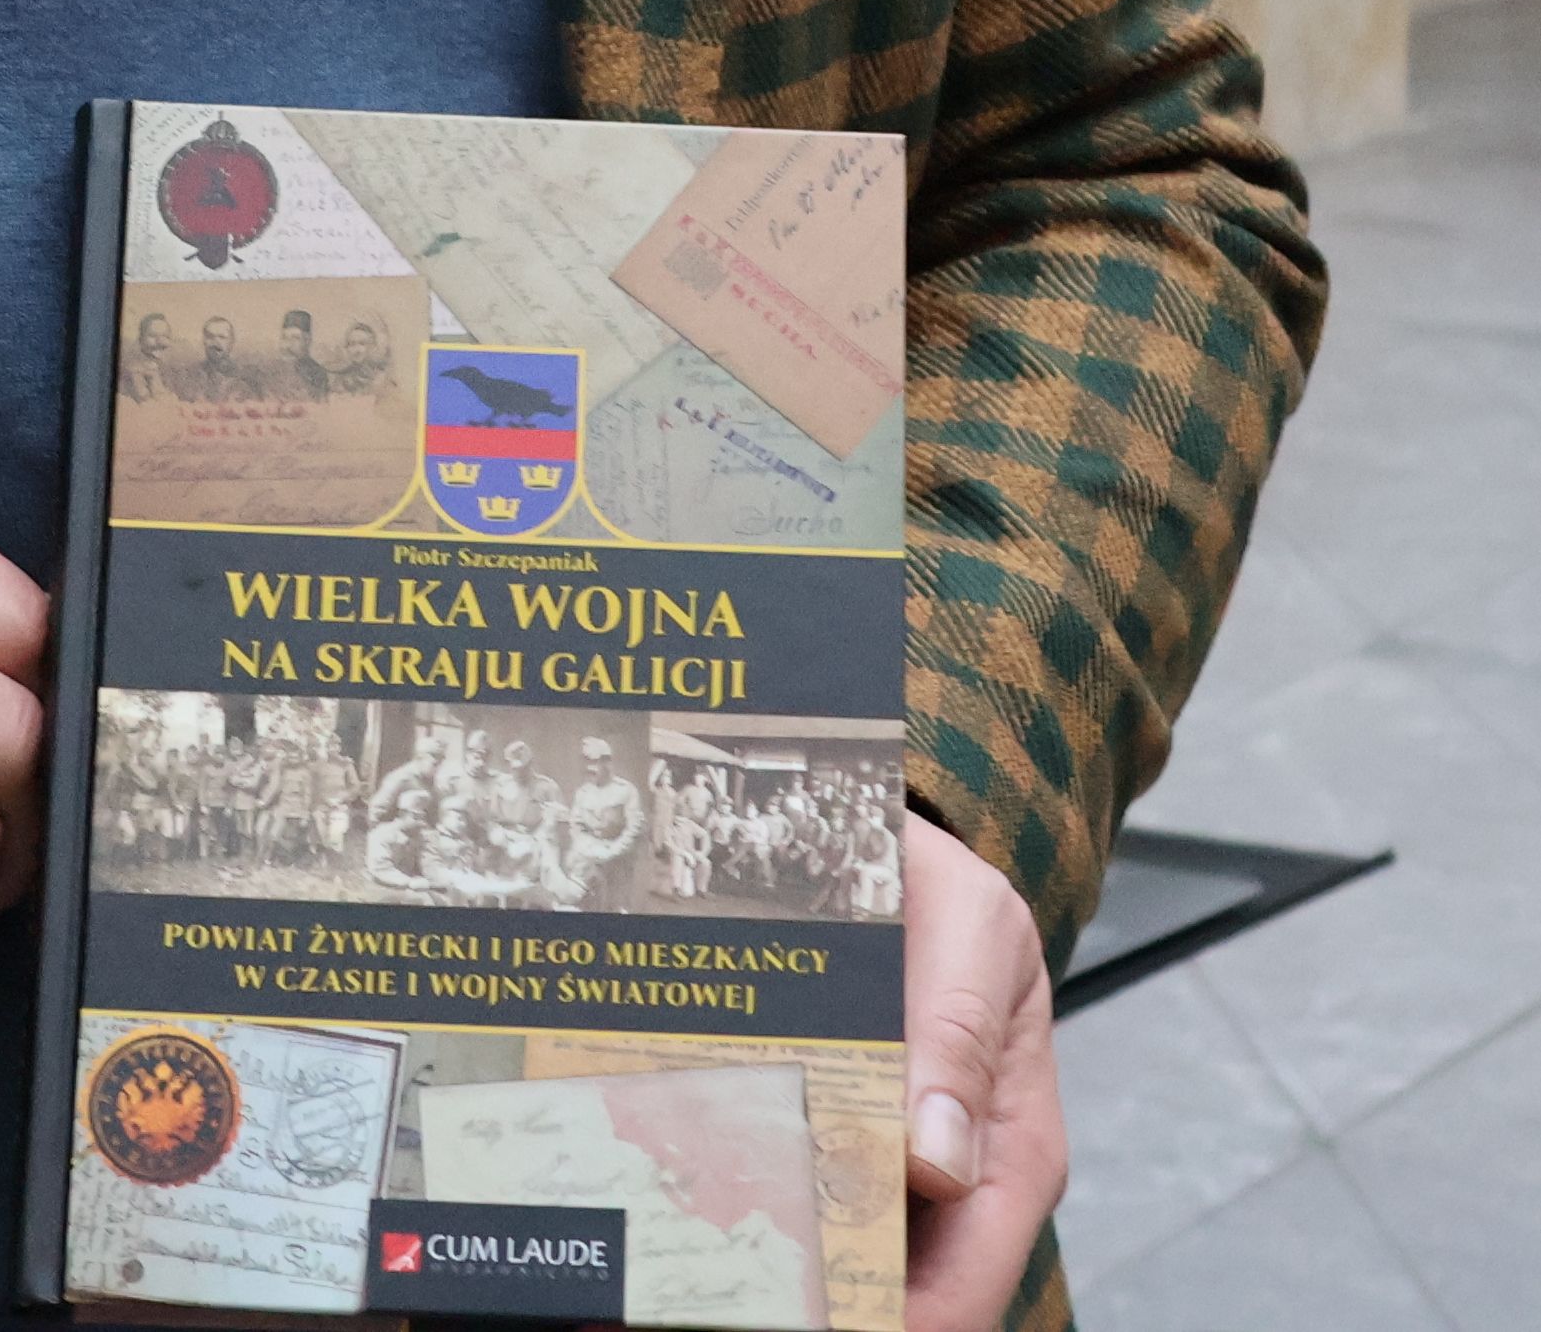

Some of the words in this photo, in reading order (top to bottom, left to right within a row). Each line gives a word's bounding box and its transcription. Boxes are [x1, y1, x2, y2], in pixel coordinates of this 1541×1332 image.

[393, 543, 451, 567] Piotr
[457, 547, 600, 574] Szczepaniak
[225, 571, 489, 630] WIELKA
[509, 582, 746, 648] WOJNA
[222, 638, 298, 682] NA
[314, 642, 525, 700] SKRAJU
[540, 652, 746, 709] GALICJI
[163, 921, 296, 953] POWIAT
[308, 920, 480, 962] ŻYWIECKI
[490, 936, 502, 962] I
[511, 938, 597, 969] JEGO
[605, 941, 829, 976] MIESZKAŃCY
[234, 964, 264, 989] W
[274, 966, 397, 996] CZASIE
[407, 972, 419, 996] I
[429, 972, 548, 1006] WOJNY
[557, 966, 757, 1015] ŚWIATOWEJ
[426, 1234, 499, 1263] CUM
[506, 1237, 610, 1268] LAUDE
